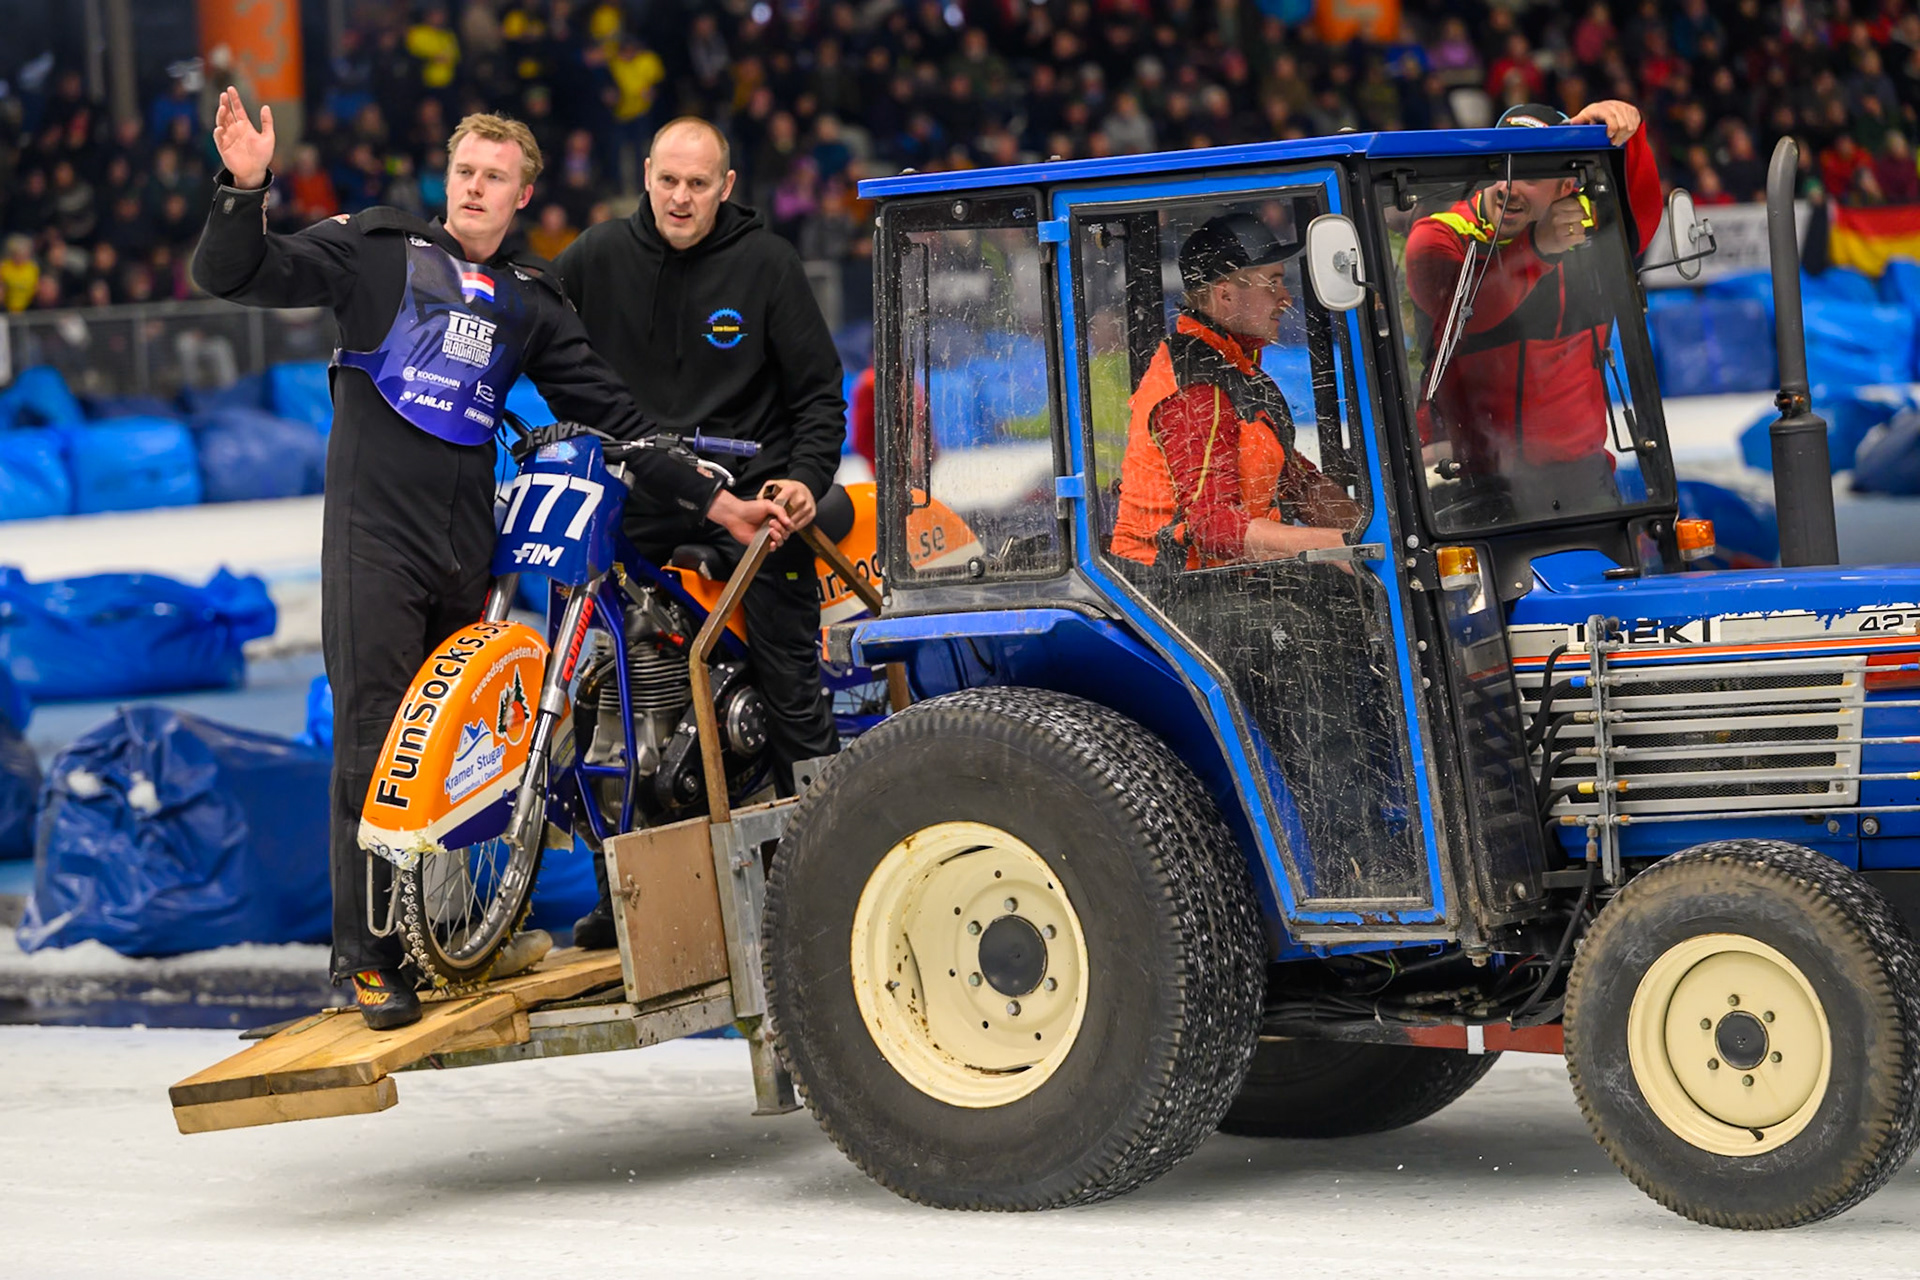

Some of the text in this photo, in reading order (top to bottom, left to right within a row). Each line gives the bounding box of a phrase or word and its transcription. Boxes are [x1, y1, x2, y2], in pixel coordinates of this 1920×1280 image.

[447, 315, 497, 346] ICE
[416, 370, 460, 388] KOOPMANN
[414, 394, 454, 412] ANLAS
[502, 473, 604, 541] 777
[513, 542, 565, 568] FIM
[1577, 618, 1710, 643] IEKI
[471, 646, 540, 704] zweedsgenieten.nl
[445, 743, 506, 793] Kramer Stugan
